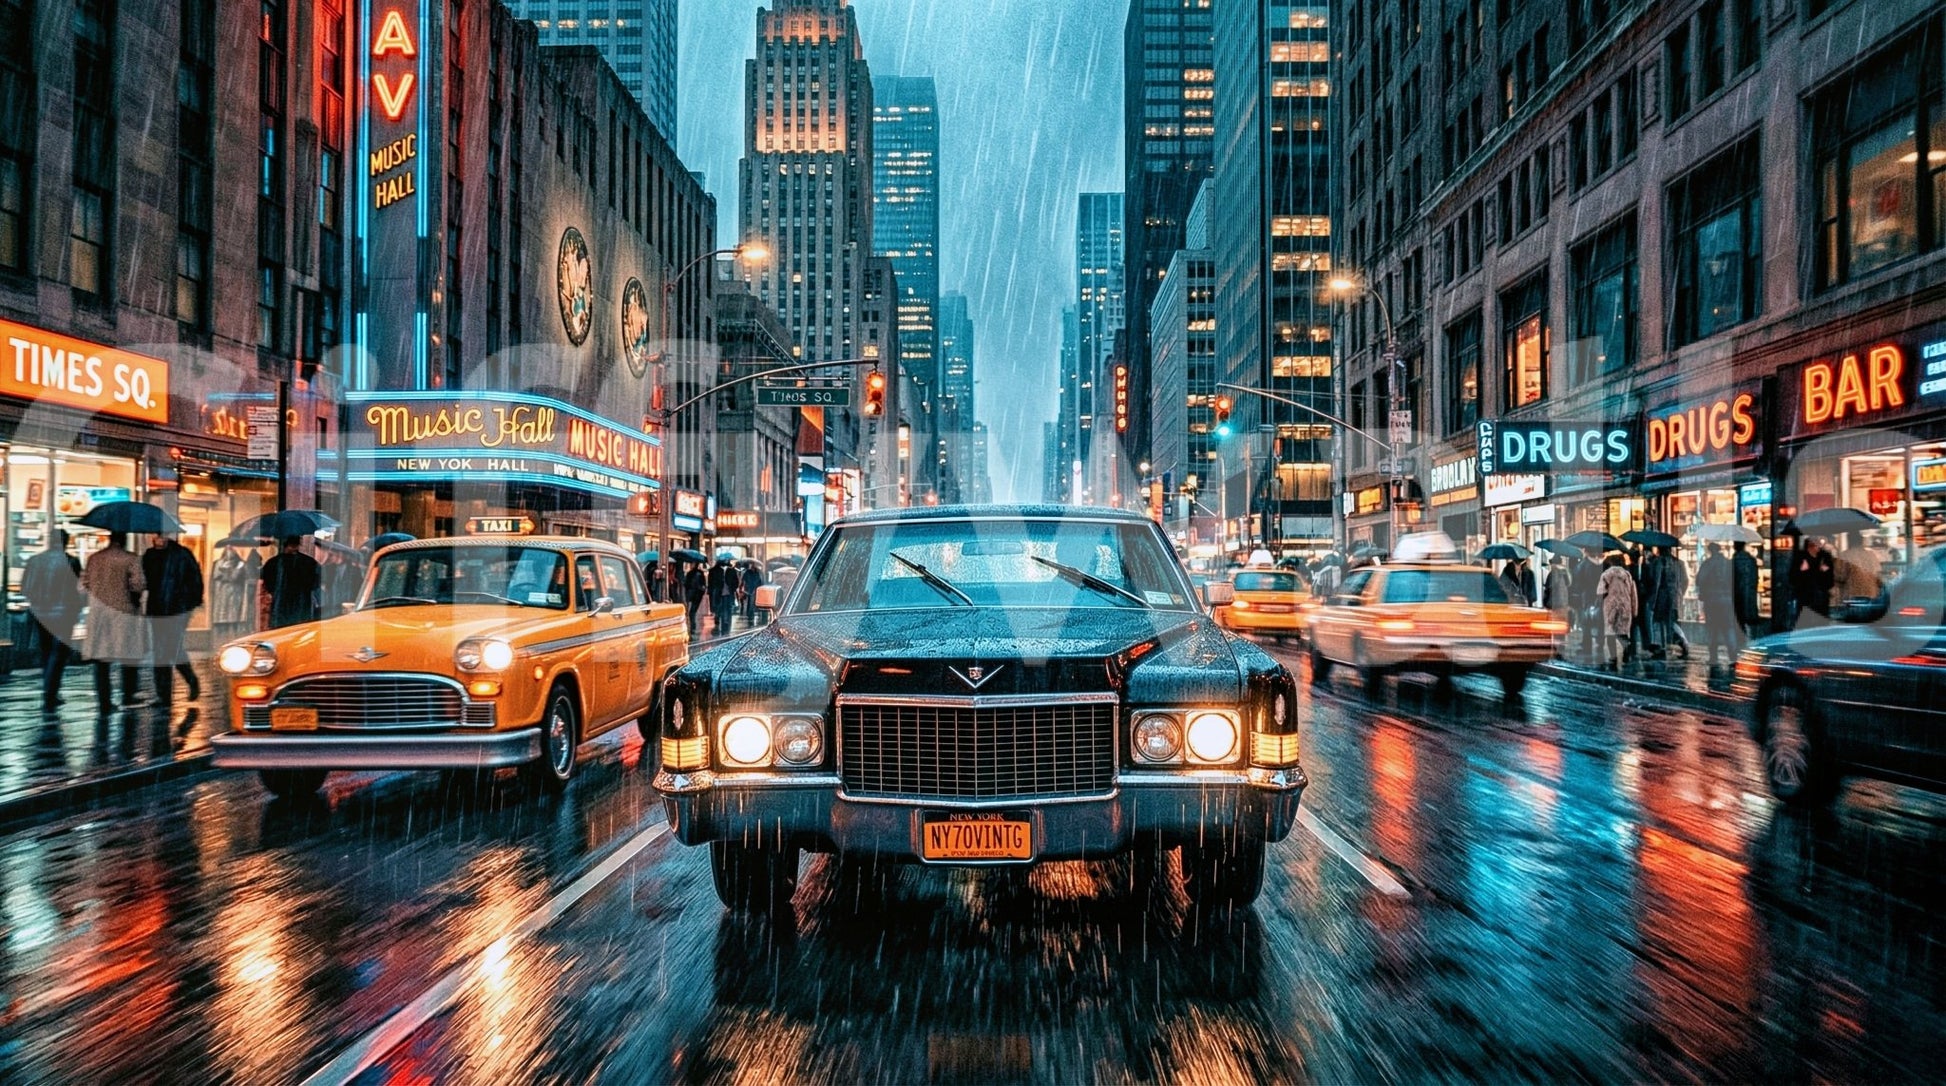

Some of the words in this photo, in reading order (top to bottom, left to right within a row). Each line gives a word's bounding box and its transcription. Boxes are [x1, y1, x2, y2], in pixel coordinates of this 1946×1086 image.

[370, 133, 416, 176] MUSIC
[375, 172, 415, 209] HALL
[9, 337, 103, 397] TIMES
[113, 363, 157, 410] SQ.
[1803, 345, 1904, 425] BAR
[367, 403, 482, 445] Music
[480, 405, 555, 447] Hall
[569, 419, 623, 467] MUSIC
[1503, 430, 1629, 463] DRUGS
[1648, 392, 1755, 463] DRUGS
[397, 458, 430, 471] NEW
[438, 458, 472, 470] YOK
[488, 459, 529, 472] HALL
[481, 520, 513, 532] TAXI
[949, 813, 973, 821] NEW
[977, 812, 1005, 821] YORK
